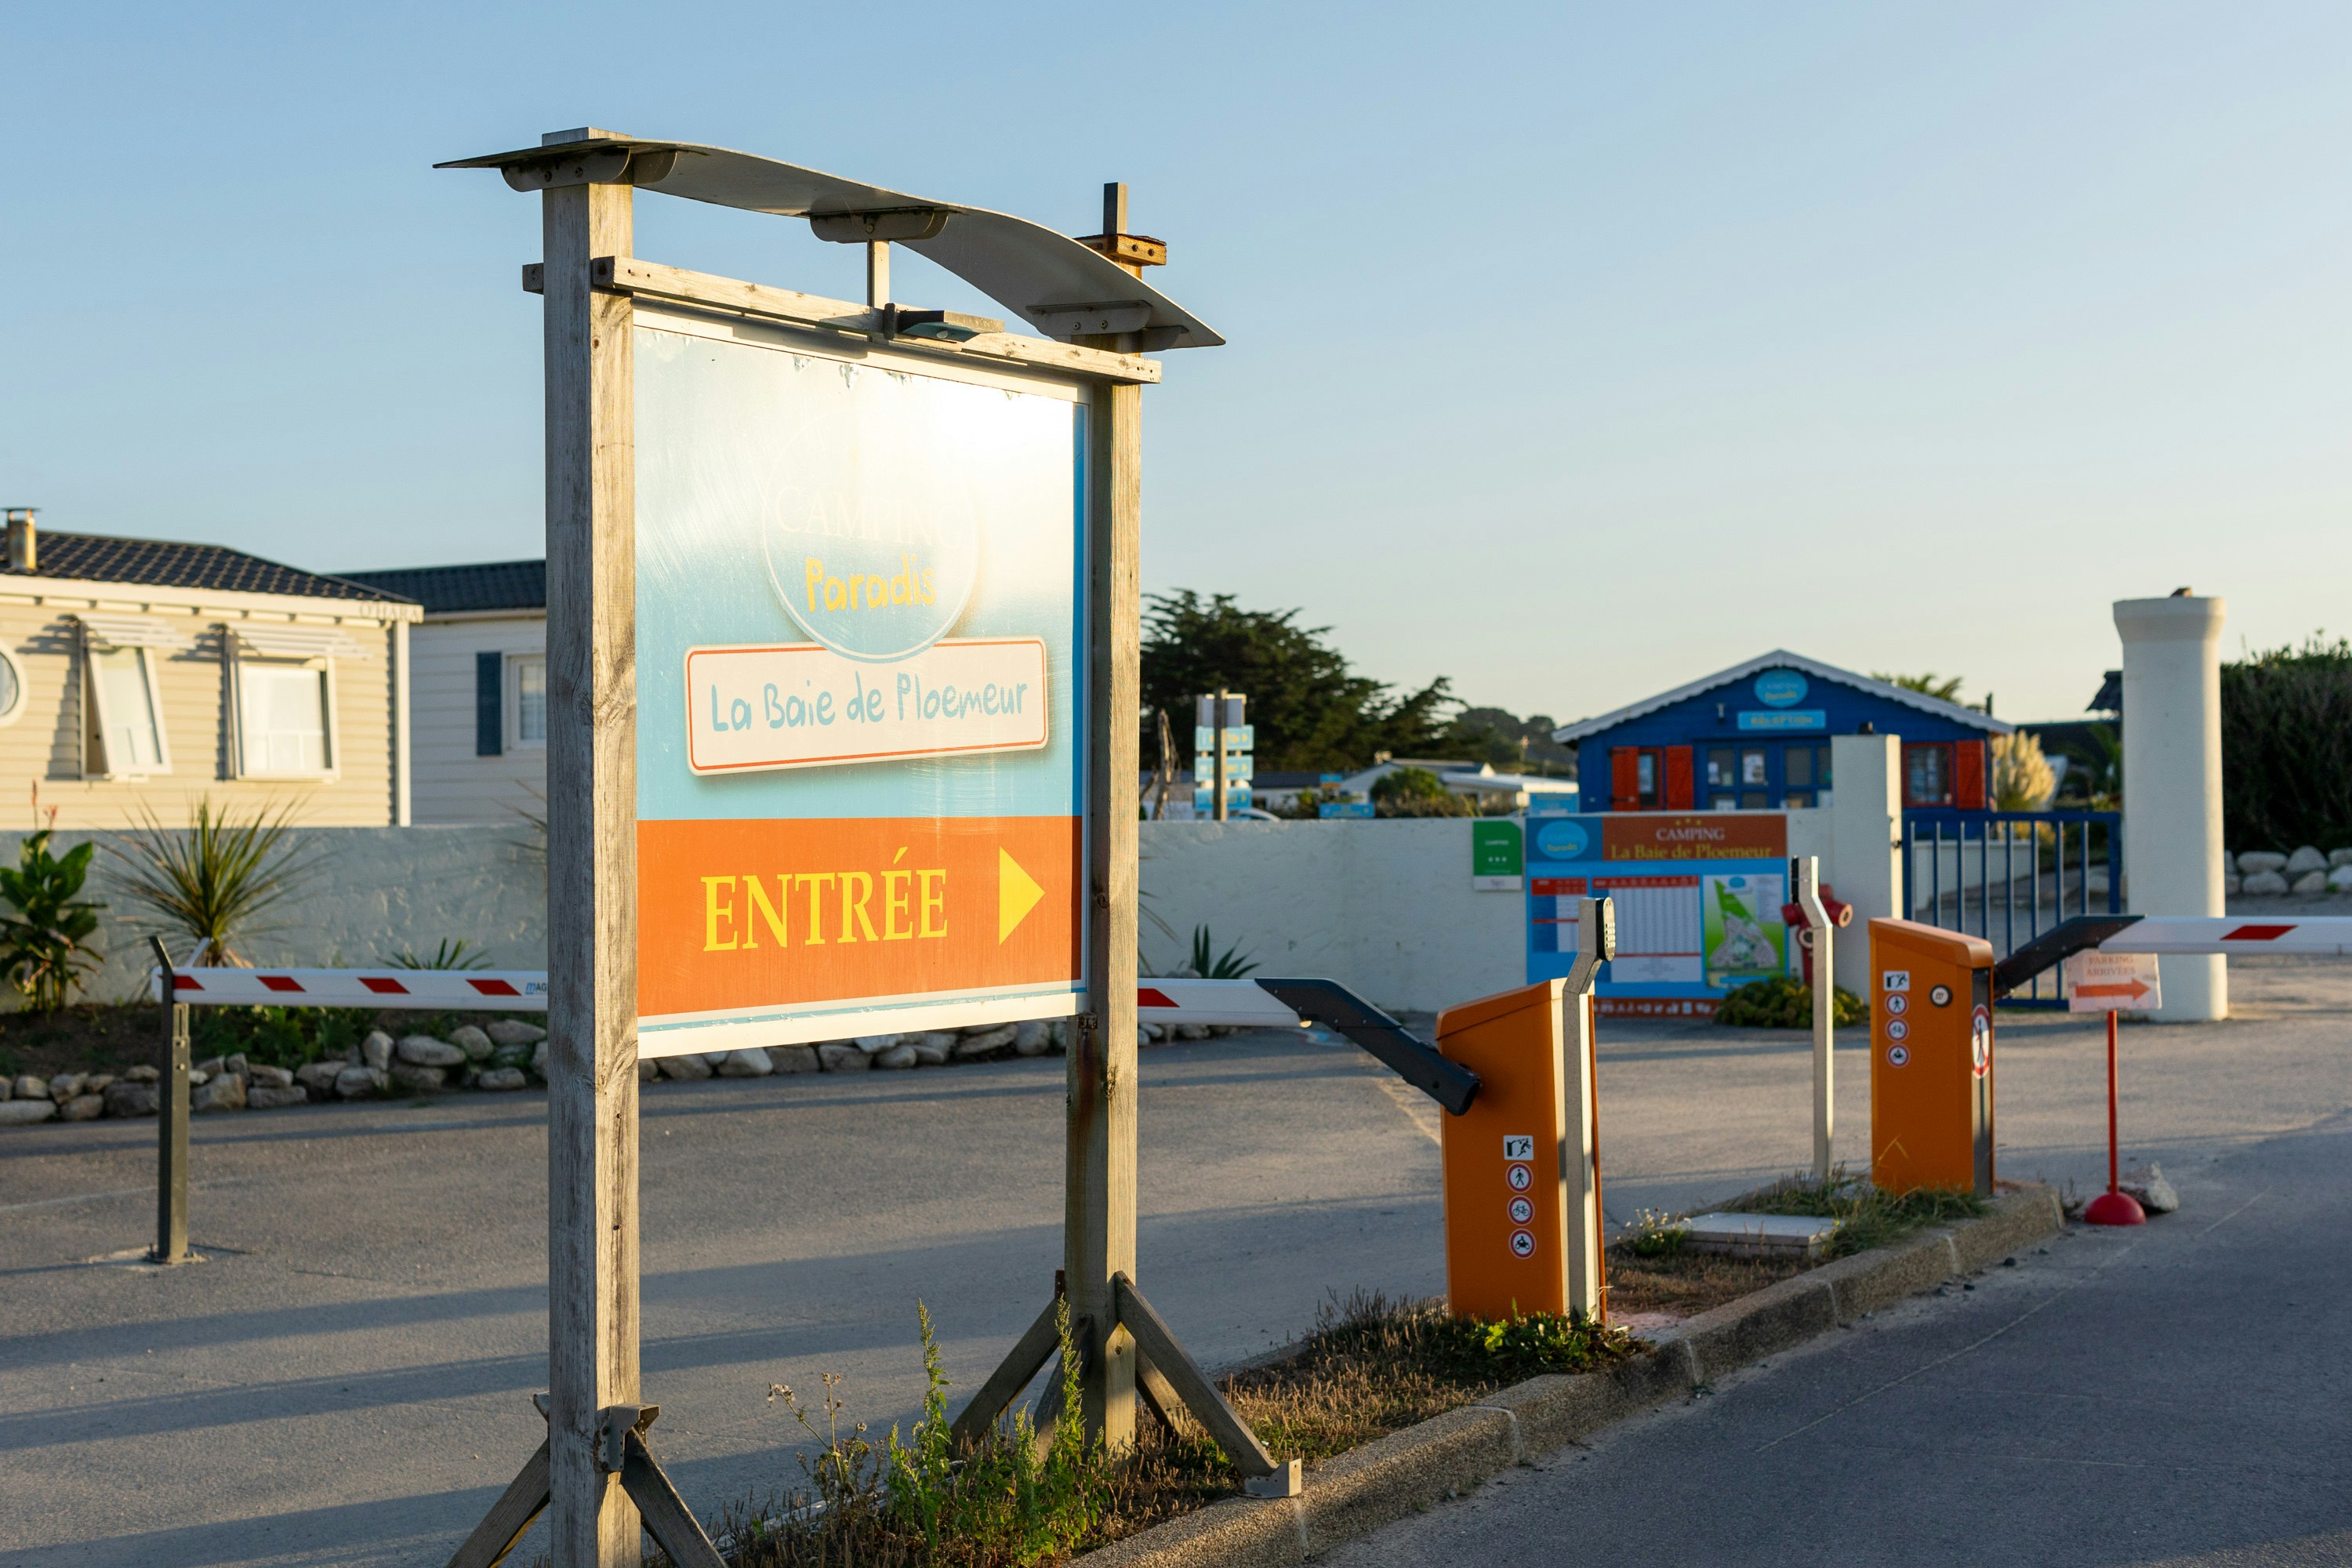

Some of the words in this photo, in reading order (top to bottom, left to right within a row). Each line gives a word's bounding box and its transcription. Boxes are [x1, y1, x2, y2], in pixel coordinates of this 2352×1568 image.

[775, 486, 963, 549] CAMPING
[805, 551, 937, 612] Paradis
[711, 684, 752, 731] La
[764, 680, 836, 729] Baie
[846, 671, 885, 724] de
[897, 672, 1028, 720] Ploemeur
[1610, 844, 1631, 860] La
[1635, 844, 1668, 859] Baie
[1671, 844, 1692, 859] de
[1696, 843, 1773, 858] Ploemeur
[1655, 827, 1726, 841] CAMPING
[700, 847, 948, 952] ENTRÉE
[2088, 956, 2134, 964] PARKING
